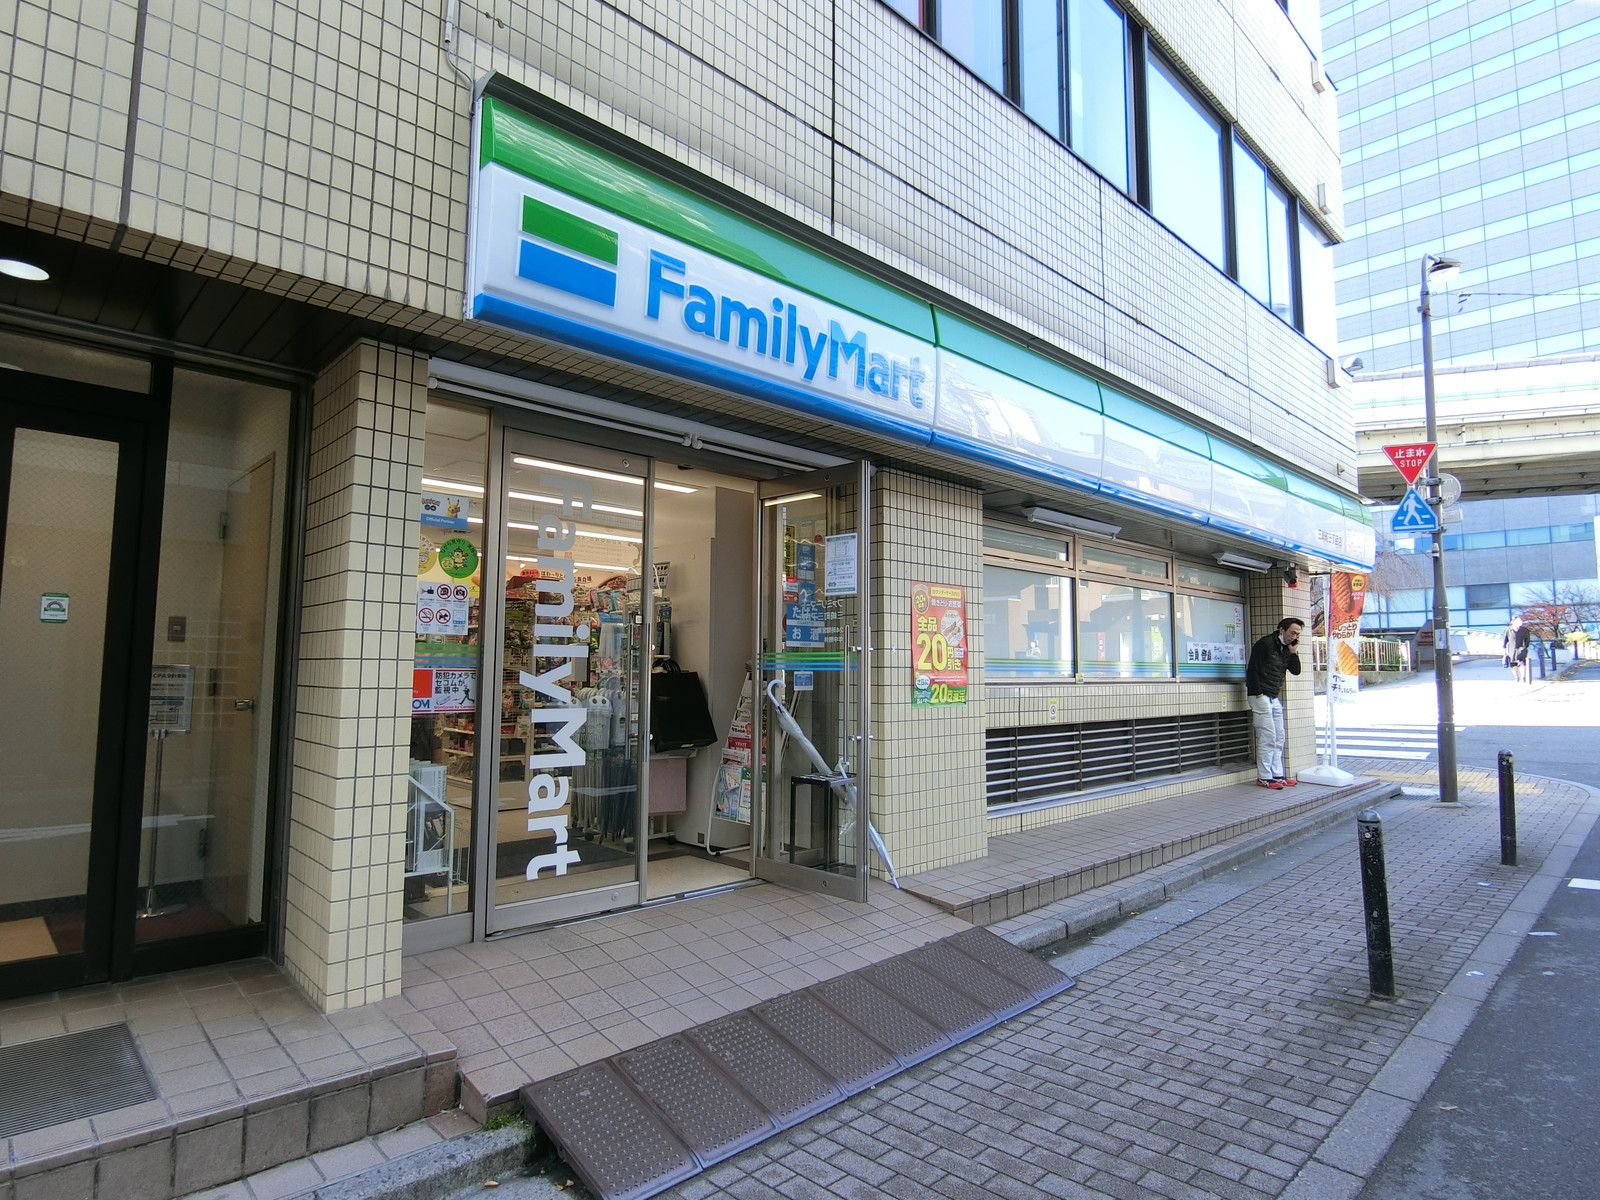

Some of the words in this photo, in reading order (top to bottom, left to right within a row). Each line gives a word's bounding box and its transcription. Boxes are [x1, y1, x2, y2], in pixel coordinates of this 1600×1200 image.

[644, 247, 927, 409] FamilyMart
[1393, 448, 1427, 459] 止まれ
[1399, 459, 1423, 468] STOP
[917, 615, 938, 632] 全品
[916, 633, 947, 671] 20
[435, 671, 476, 680] 防犯カメラで
[519, 474, 594, 881] FamilyMart
[434, 686, 460, 694] 監視中
[435, 679, 466, 687] セコムが
[930, 683, 948, 704] 20
